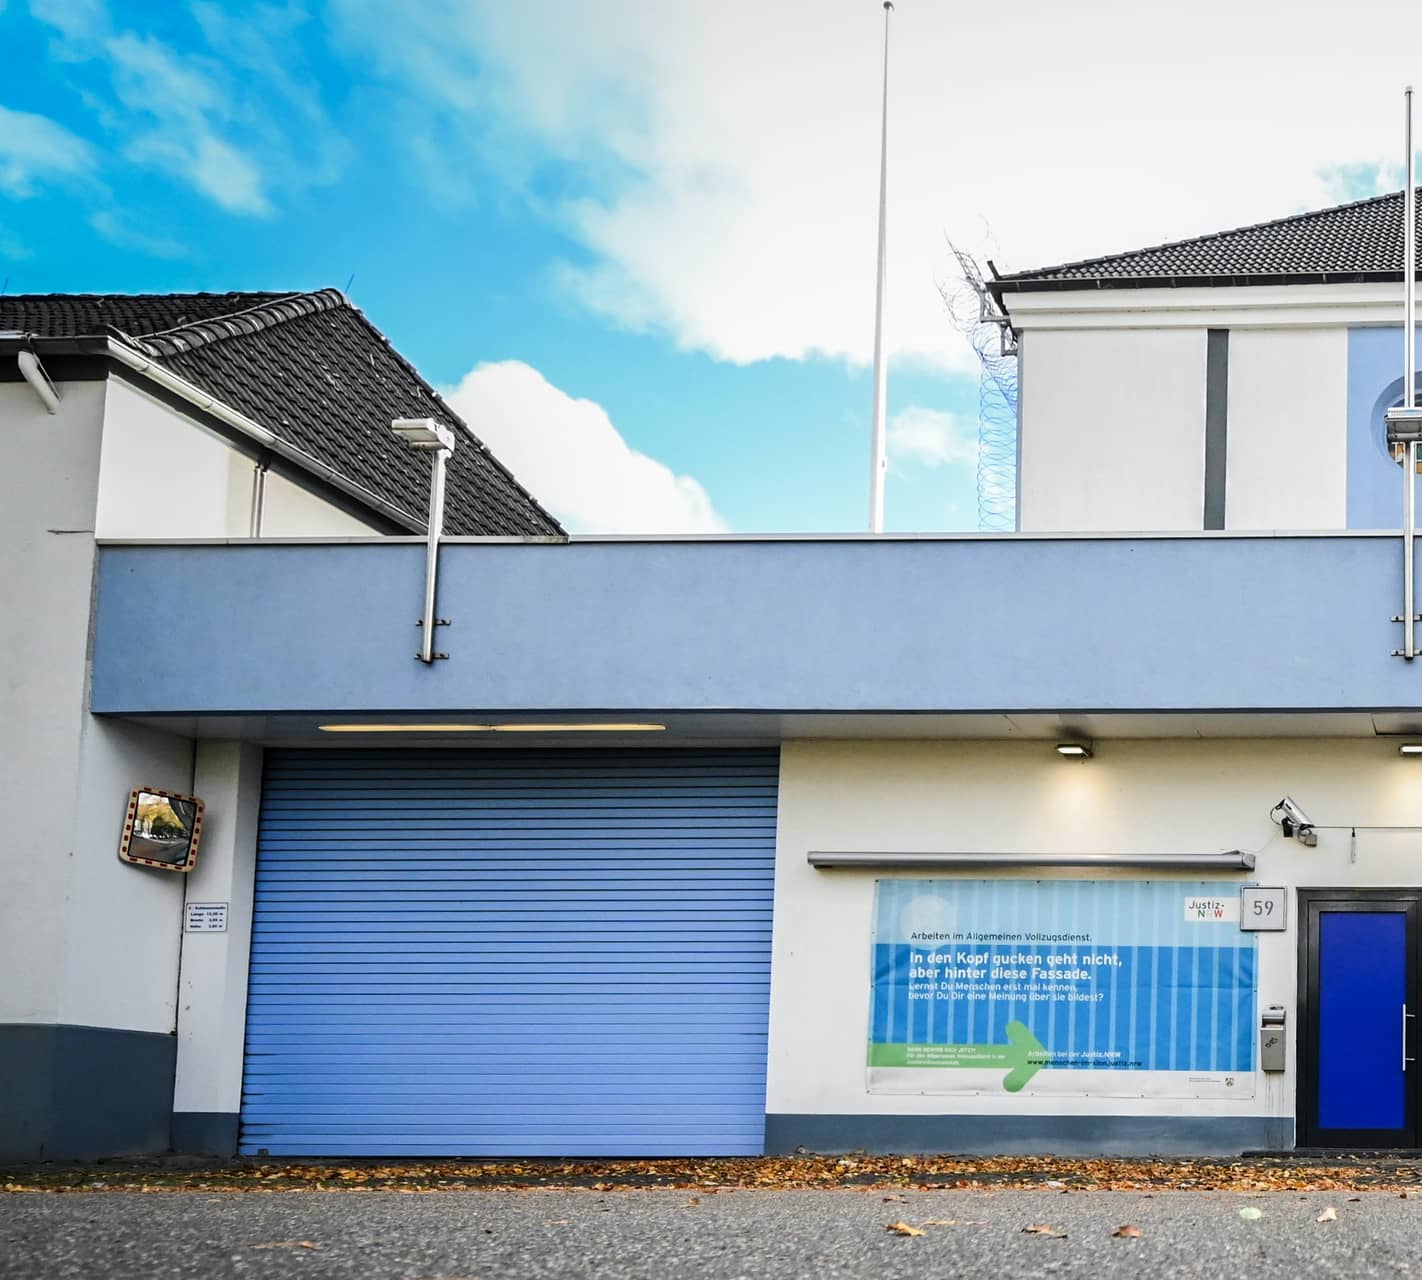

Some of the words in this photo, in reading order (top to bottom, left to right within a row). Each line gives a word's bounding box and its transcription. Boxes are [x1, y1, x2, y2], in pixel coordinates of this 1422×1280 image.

[1254, 900, 1274, 916] 59
[1198, 910, 1223, 918] NW
[911, 932, 950, 940] Arbeiten
[952, 932, 964, 940] im
[966, 932, 1022, 942] Allgemeinen
[1025, 932, 1092, 942] Vollzugsdienst.
[910, 951, 923, 964] In
[927, 952, 952, 964] den
[956, 952, 989, 966] Kopf
[993, 952, 1042, 966] gucken
[1046, 952, 1078, 968] geht
[1082, 953, 1122, 968] nicht,
[910, 966, 940, 978] aber
[944, 966, 986, 979] hinter
[991, 967, 1028, 980] diese
[1032, 968, 1092, 980] Fassade.
[909, 982, 938, 990] Lernst
[940, 982, 954, 990] Du
[956, 982, 1001, 991] Menschen
[1003, 982, 1021, 991] erst
[1024, 983, 1040, 992] mal
[908, 992, 934, 1000] bevor
[936, 992, 949, 1000] Du
[952, 992, 965, 1000] Dir
[967, 992, 986, 1000] eine
[988, 992, 1026, 1002] Meinung
[1030, 992, 1049, 1001] über
[1053, 992, 1066, 1001] sie
[1068, 992, 1104, 1002] bildest?
